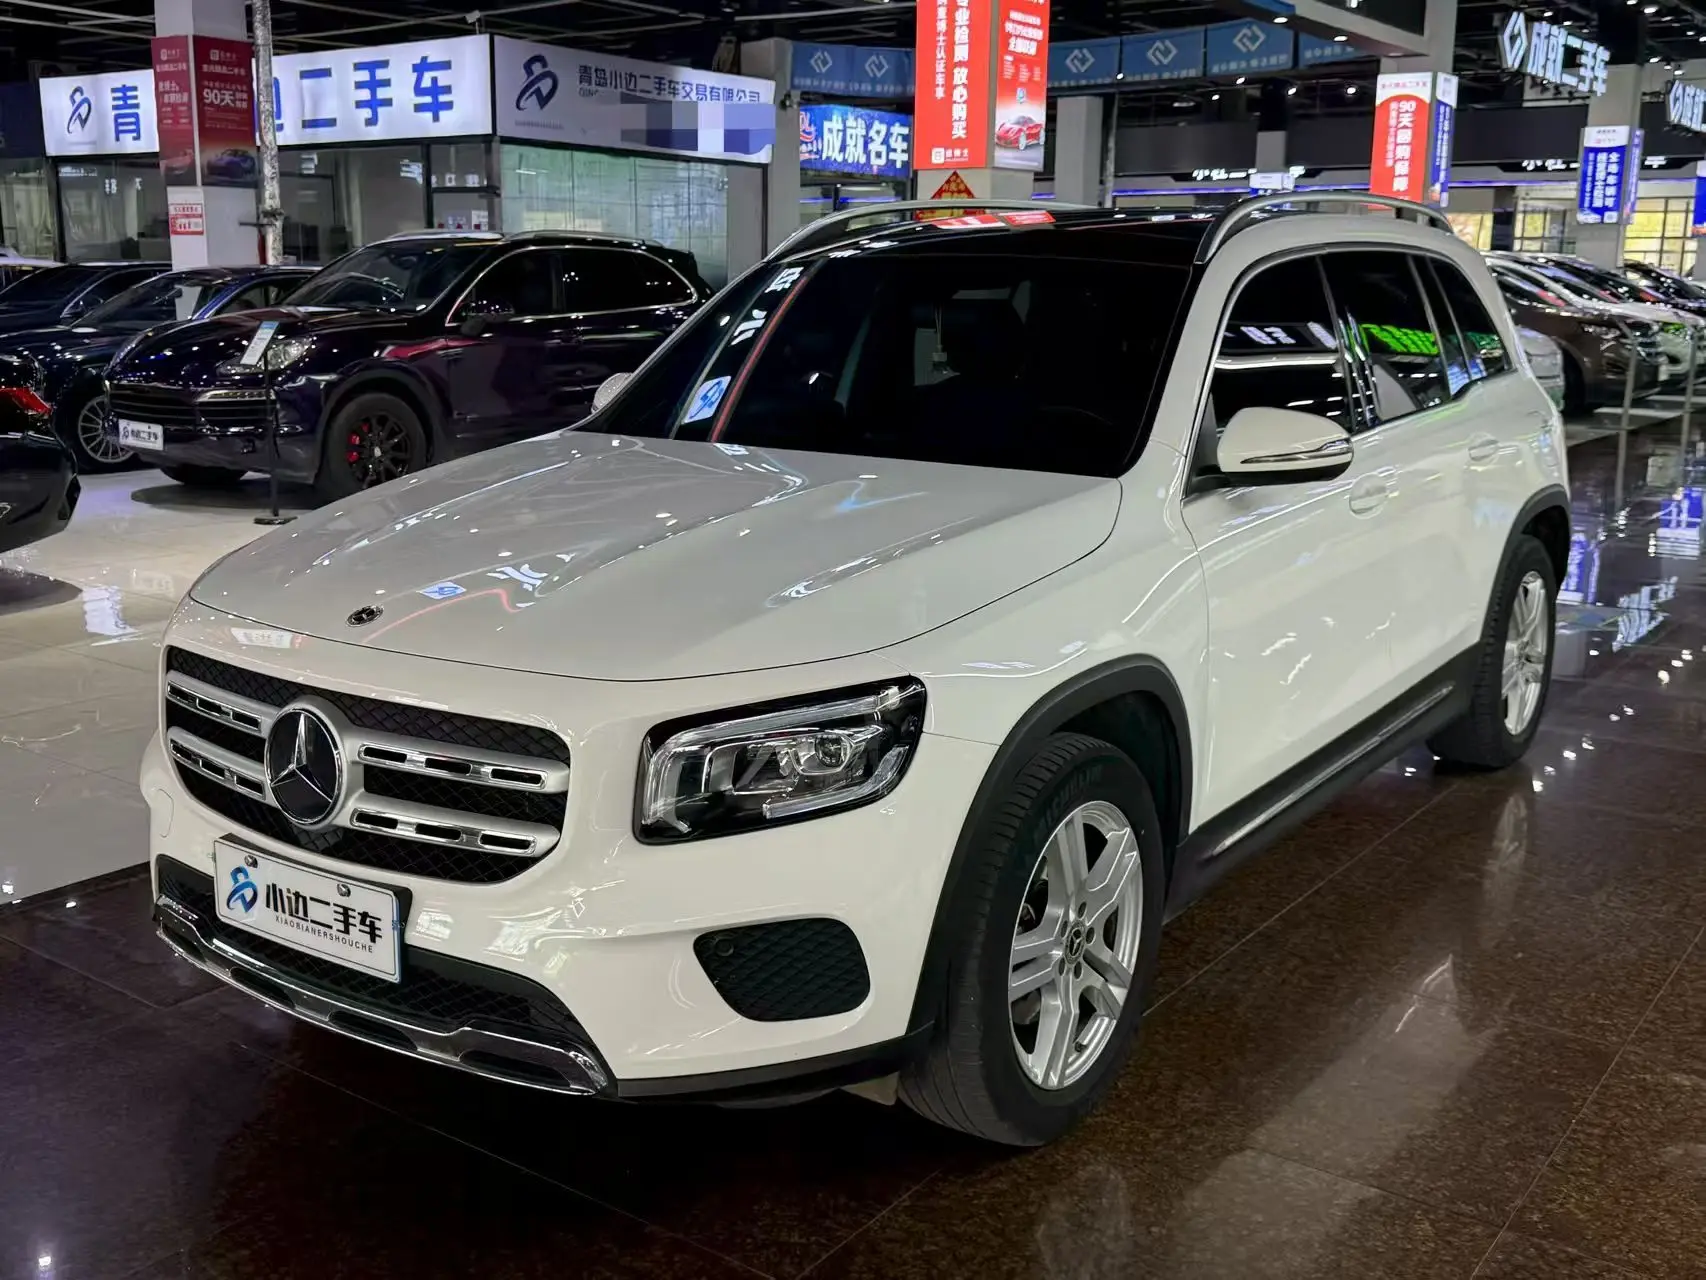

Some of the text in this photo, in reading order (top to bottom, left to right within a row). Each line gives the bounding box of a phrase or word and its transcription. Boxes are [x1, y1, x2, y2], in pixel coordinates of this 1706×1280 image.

[578, 64, 761, 103] 青岛小边二手车交易有限公司
[110, 84, 141, 142] 青
[822, 111, 910, 169] 成就名车
[265, 883, 383, 944] 小边二手车
